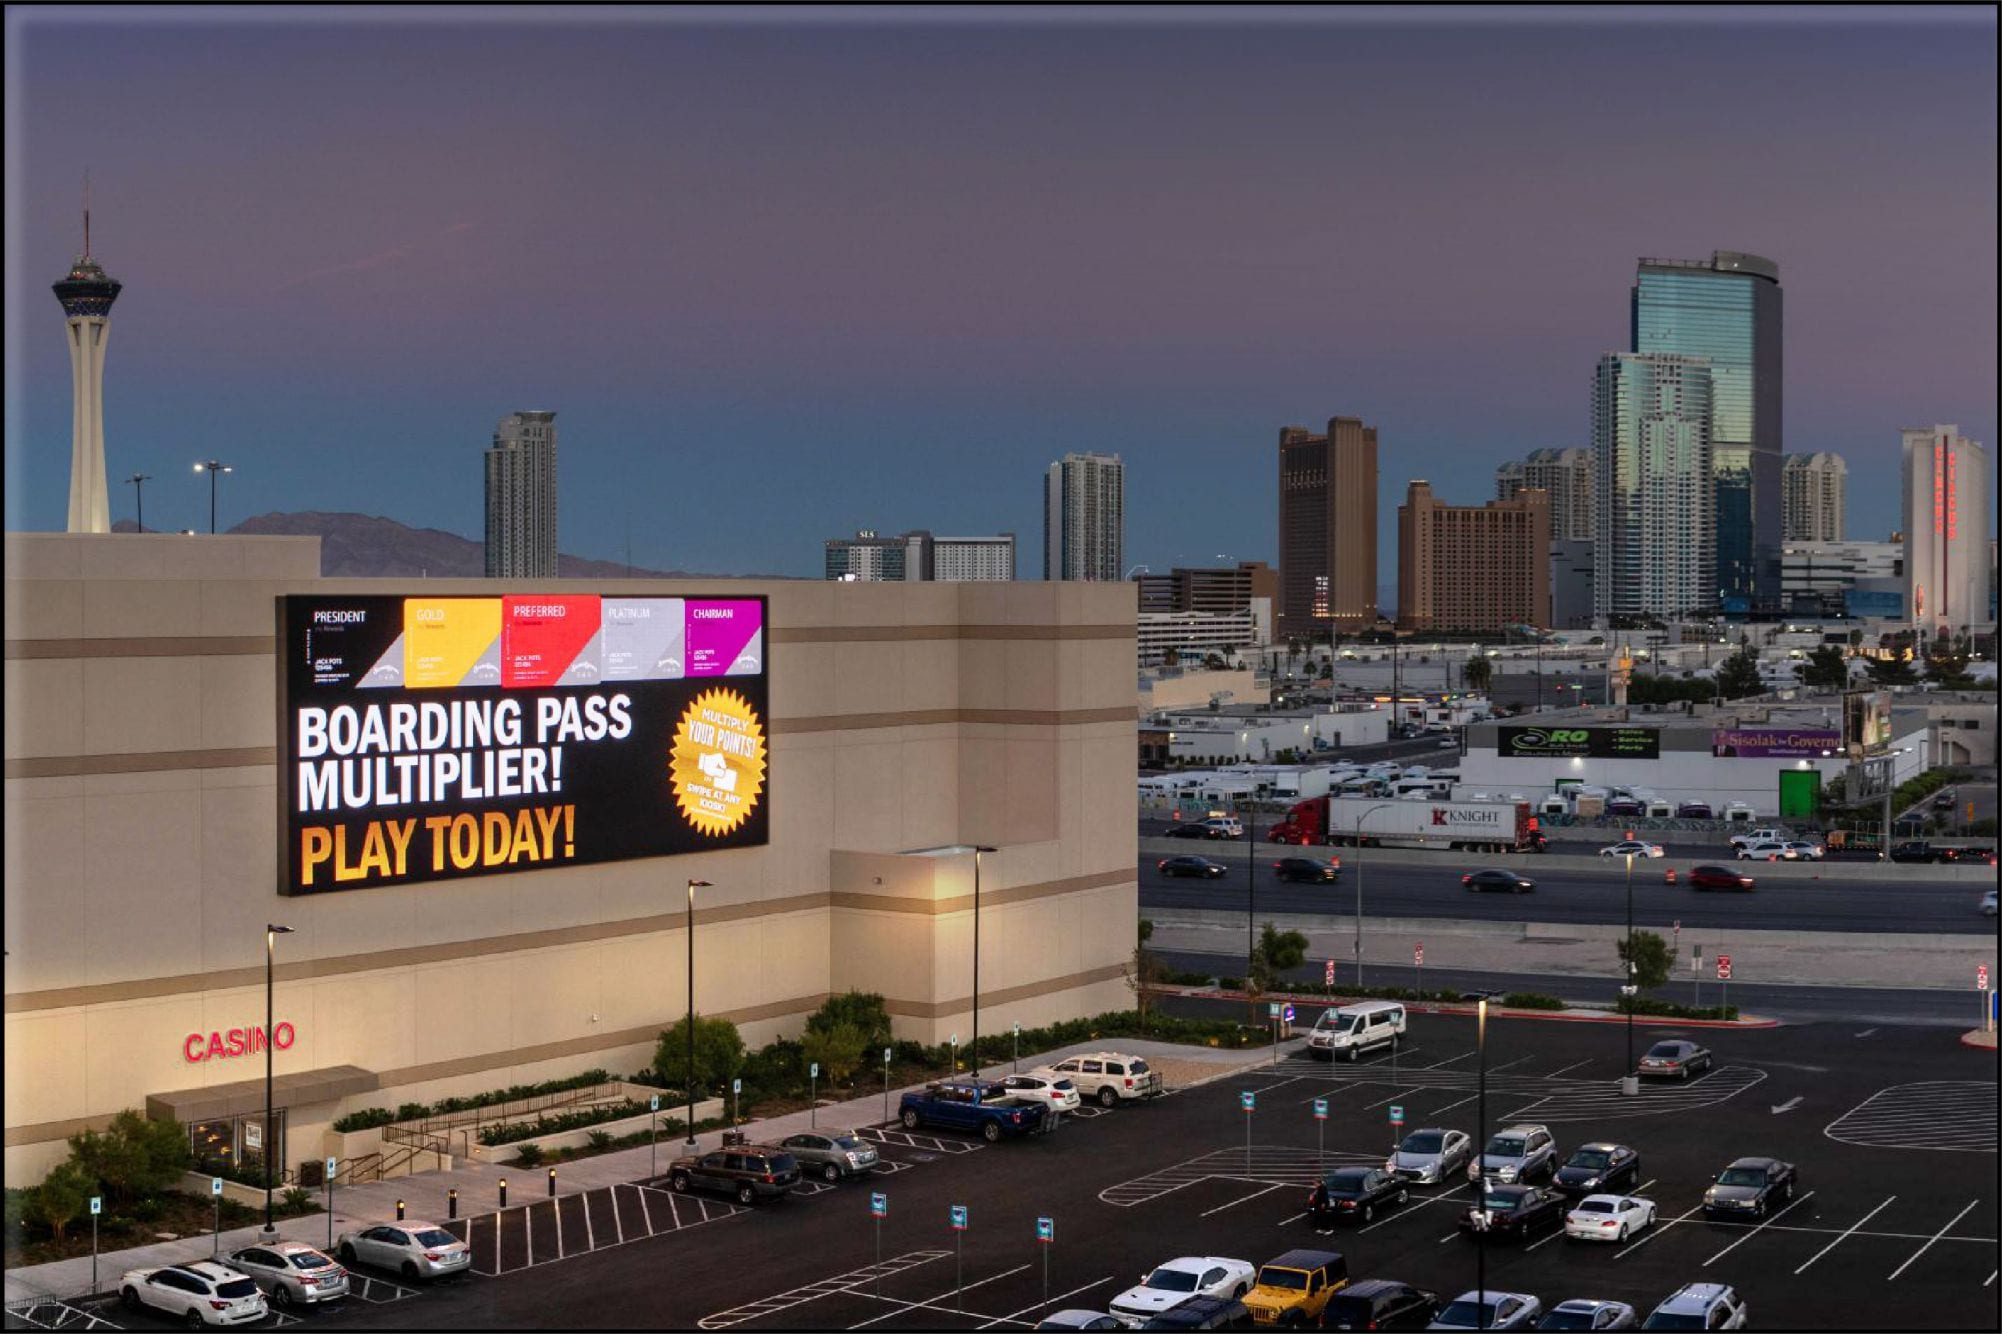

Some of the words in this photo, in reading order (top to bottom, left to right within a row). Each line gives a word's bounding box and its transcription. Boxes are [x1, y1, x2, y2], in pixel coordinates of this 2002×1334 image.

[314, 610, 366, 623] PRESIDENT
[416, 609, 444, 622] GOLD
[513, 605, 566, 618] PREFERRED
[608, 607, 650, 619] PLATINUM
[693, 608, 734, 619] CHAIRMAN
[299, 698, 522, 757] BOARDING
[537, 693, 632, 743] PASS
[702, 708, 749, 732] MULTIPLY
[688, 720, 715, 747] YOUR
[717, 727, 757, 758] POINTS!
[1550, 730, 1589, 743] RO
[1729, 734, 1777, 746] Sisolak
[1788, 735, 1842, 747] Governo
[299, 746, 562, 812] MULTIPLIER!
[1450, 810, 1499, 822] KNIGHT
[301, 818, 417, 886] PLAY
[425, 804, 576, 872] TODAY!
[184, 1021, 295, 1063] CASINO
